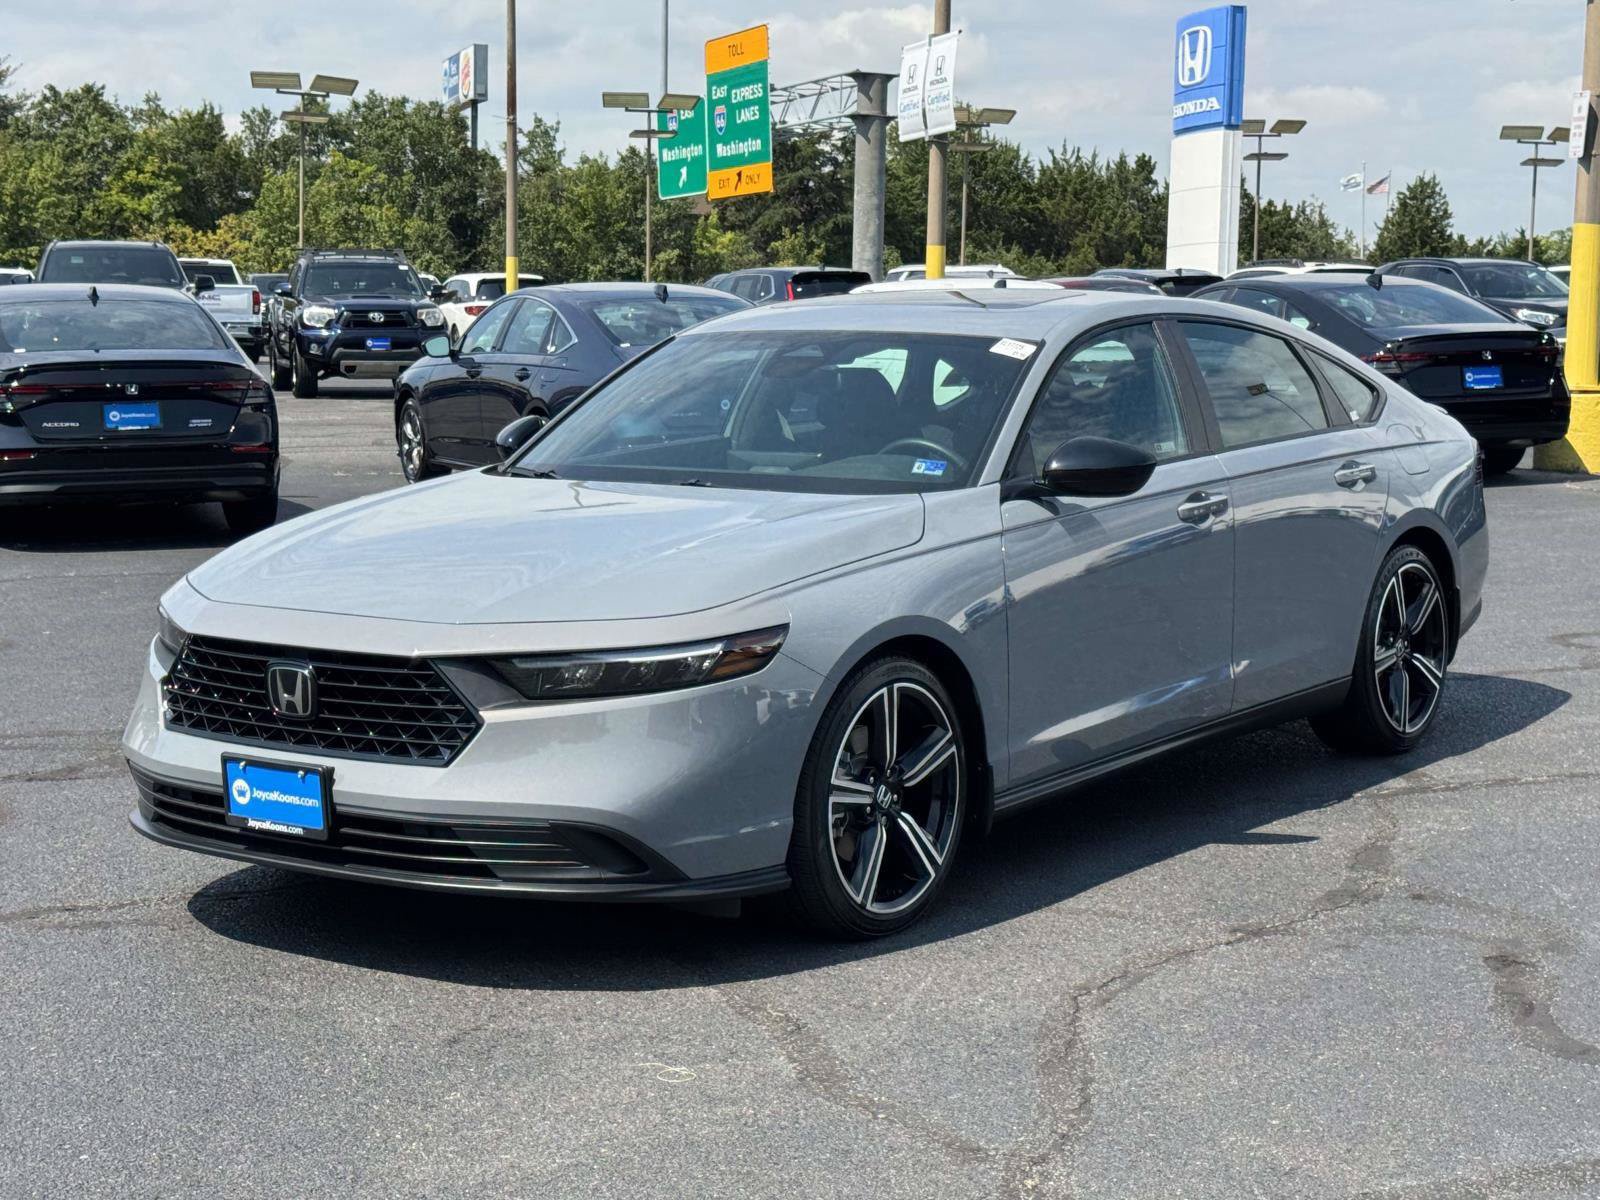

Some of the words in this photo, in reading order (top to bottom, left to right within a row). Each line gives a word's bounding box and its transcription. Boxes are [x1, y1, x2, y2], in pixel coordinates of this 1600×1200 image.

[728, 43, 744, 58] TOLL
[712, 86, 727, 99] EAST
[732, 84, 762, 103] EXPRESS
[735, 105, 760, 124] LANES
[1173, 97, 1220, 118] HONDA
[715, 114, 726, 126] 66
[662, 143, 703, 162] Washington
[716, 138, 762, 158] Washington
[718, 177, 731, 189] EXIT
[745, 173, 761, 185] ONLY
[252, 788, 318, 806] JoyceKoons.com
[248, 819, 303, 834] JoyceKoons.com
